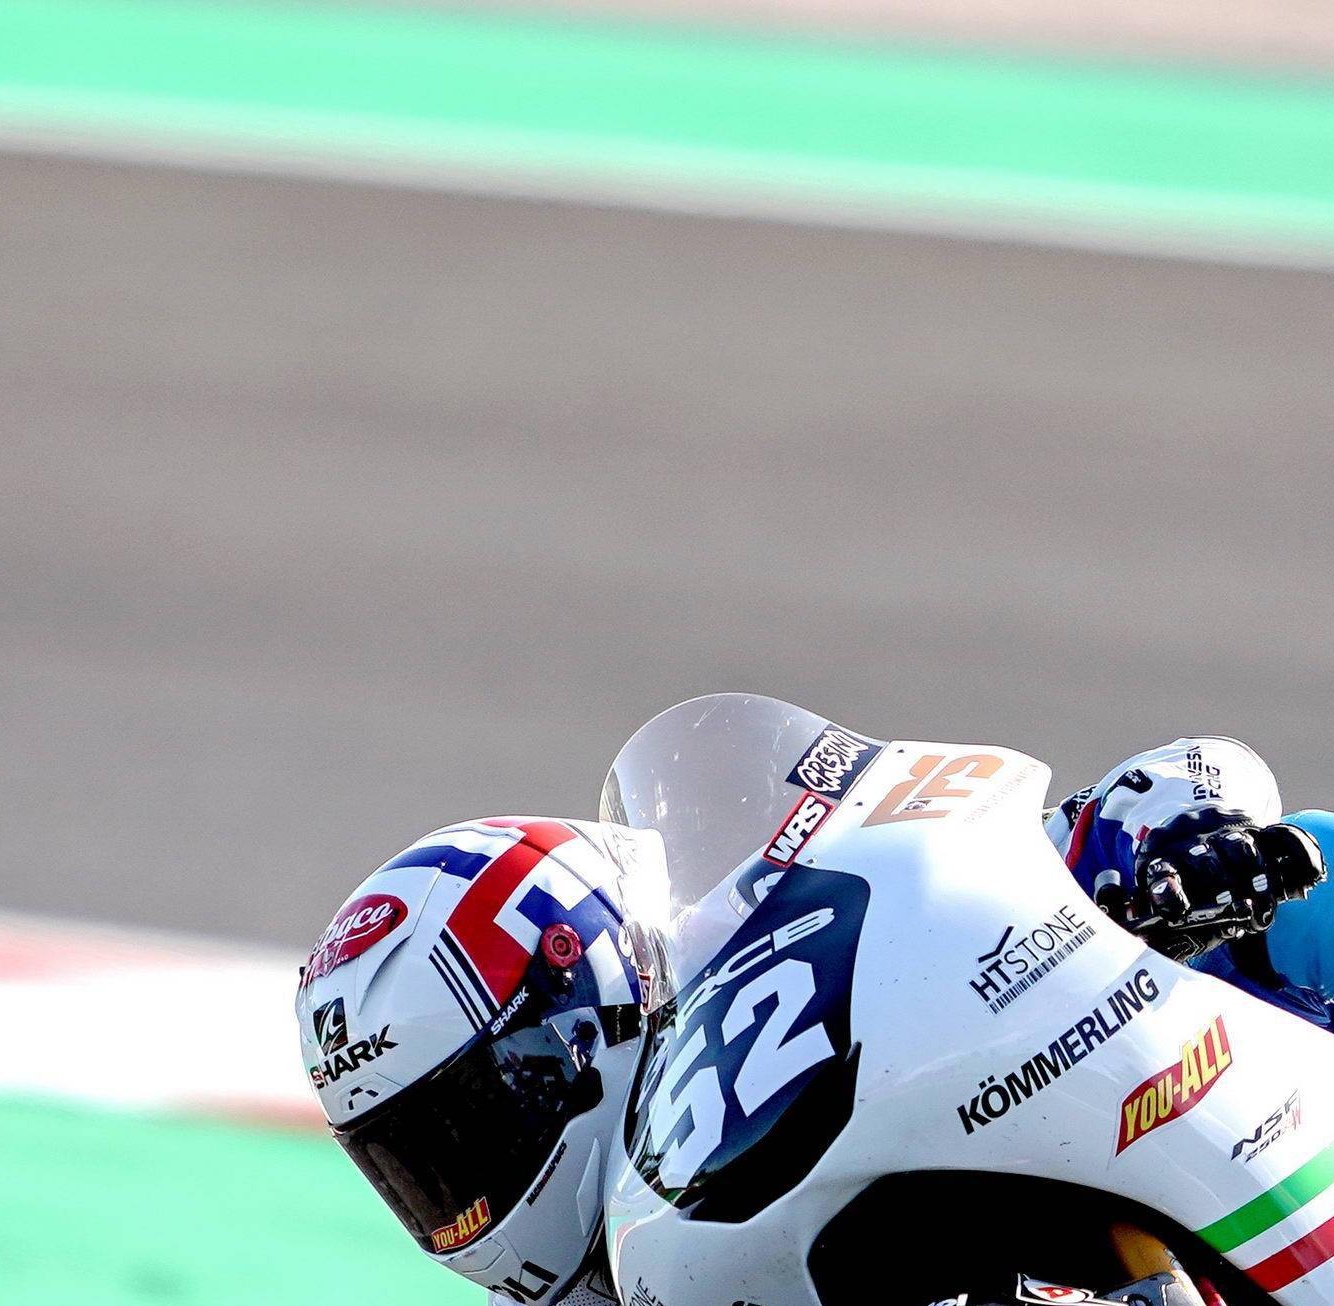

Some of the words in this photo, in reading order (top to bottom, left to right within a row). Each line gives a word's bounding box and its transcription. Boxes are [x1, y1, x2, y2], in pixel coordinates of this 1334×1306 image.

[767, 796, 827, 863] WRS
[969, 905, 1086, 1003] HTSTONE
[489, 985, 530, 1036] SHARK
[310, 1024, 399, 1090] SHARK
[648, 958, 836, 1190] 52
[957, 968, 1160, 1136] KÖMMERLING
[1124, 1017, 1233, 1143] YOU-ALL
[433, 1199, 488, 1250] YOU-ALL
